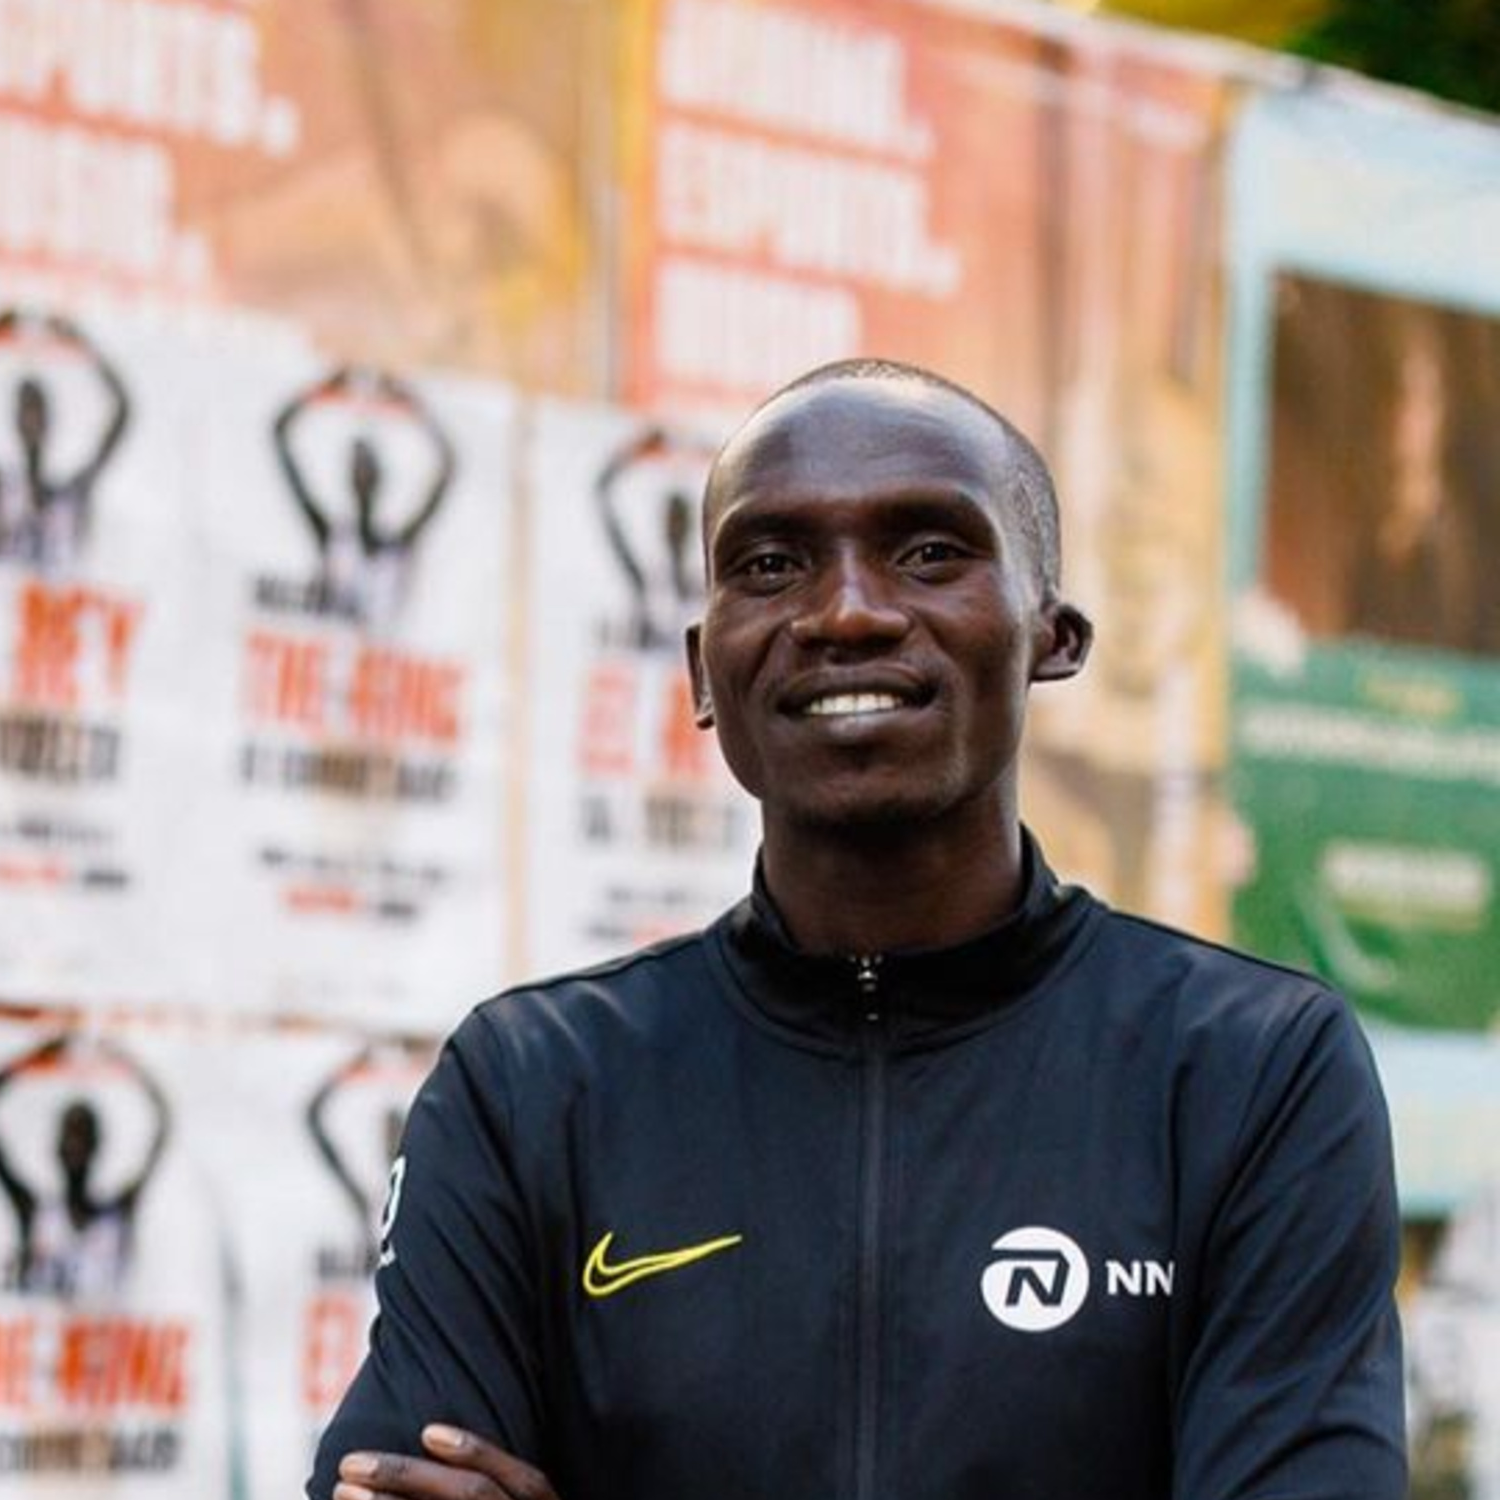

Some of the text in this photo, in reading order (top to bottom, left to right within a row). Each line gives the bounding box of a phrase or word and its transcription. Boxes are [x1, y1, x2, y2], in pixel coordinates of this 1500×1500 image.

[15, 580, 142, 705] REY
[1105, 1259, 1174, 1296] NN
[55, 1318, 190, 1418] KING
